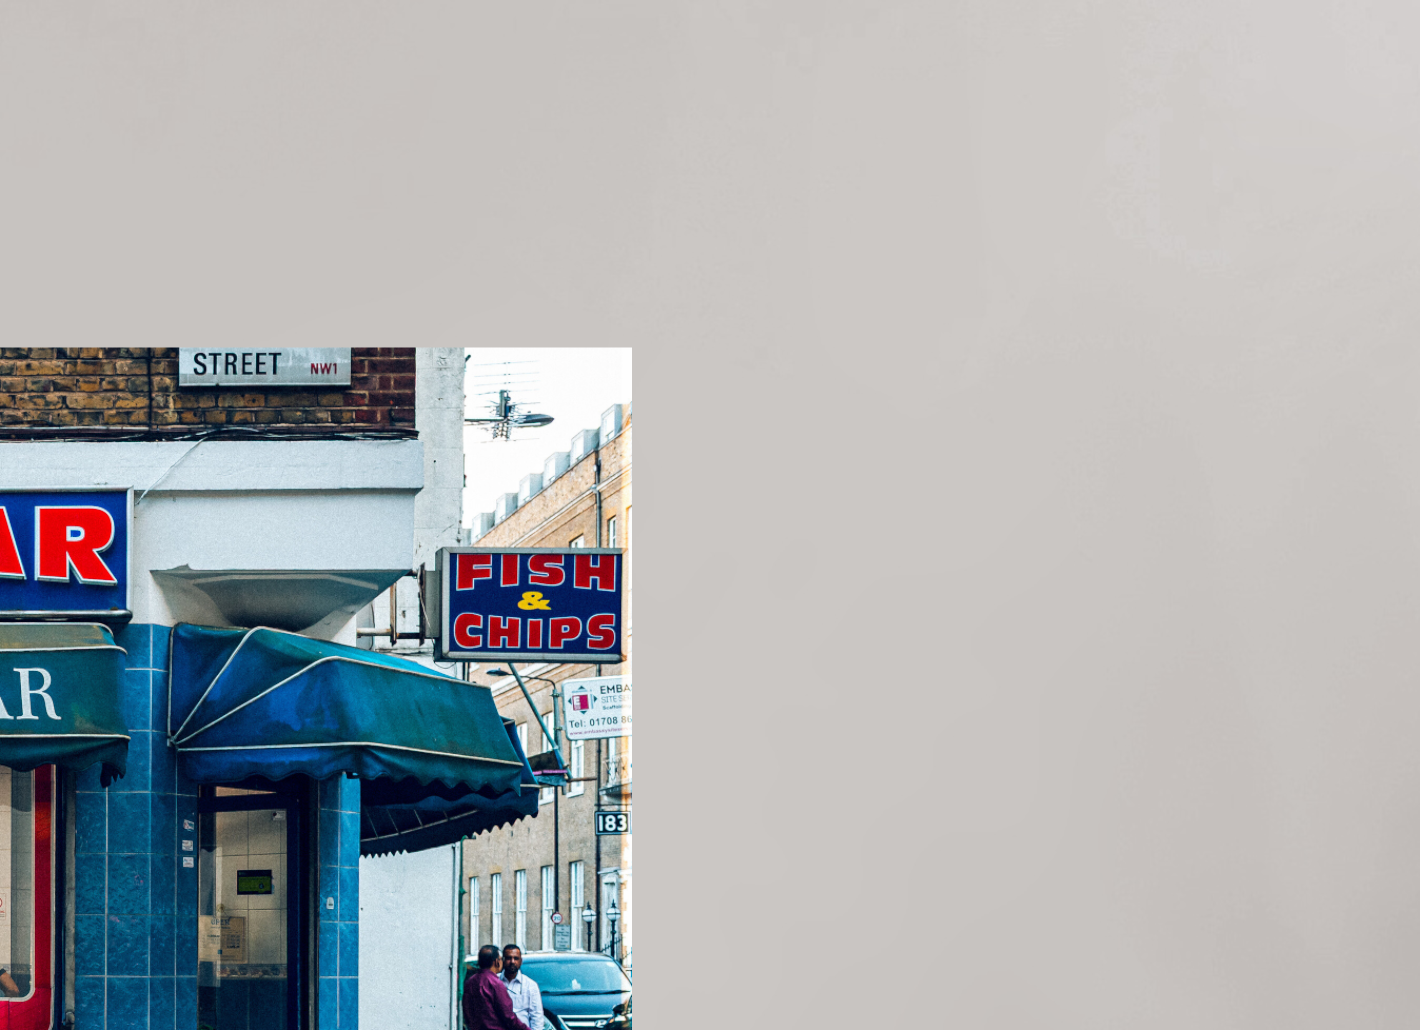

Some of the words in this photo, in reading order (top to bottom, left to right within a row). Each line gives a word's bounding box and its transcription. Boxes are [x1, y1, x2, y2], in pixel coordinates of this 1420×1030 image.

[193, 352, 282, 376] STREET
[310, 362, 338, 375] NW1
[455, 553, 617, 593] FISH
[517, 591, 552, 611] &
[453, 612, 616, 650] CHIPS
[600, 683, 632, 695] EMBA
[569, 718, 587, 729] Tel:
[589, 716, 618, 727] 01708
[598, 814, 628, 832] 183
